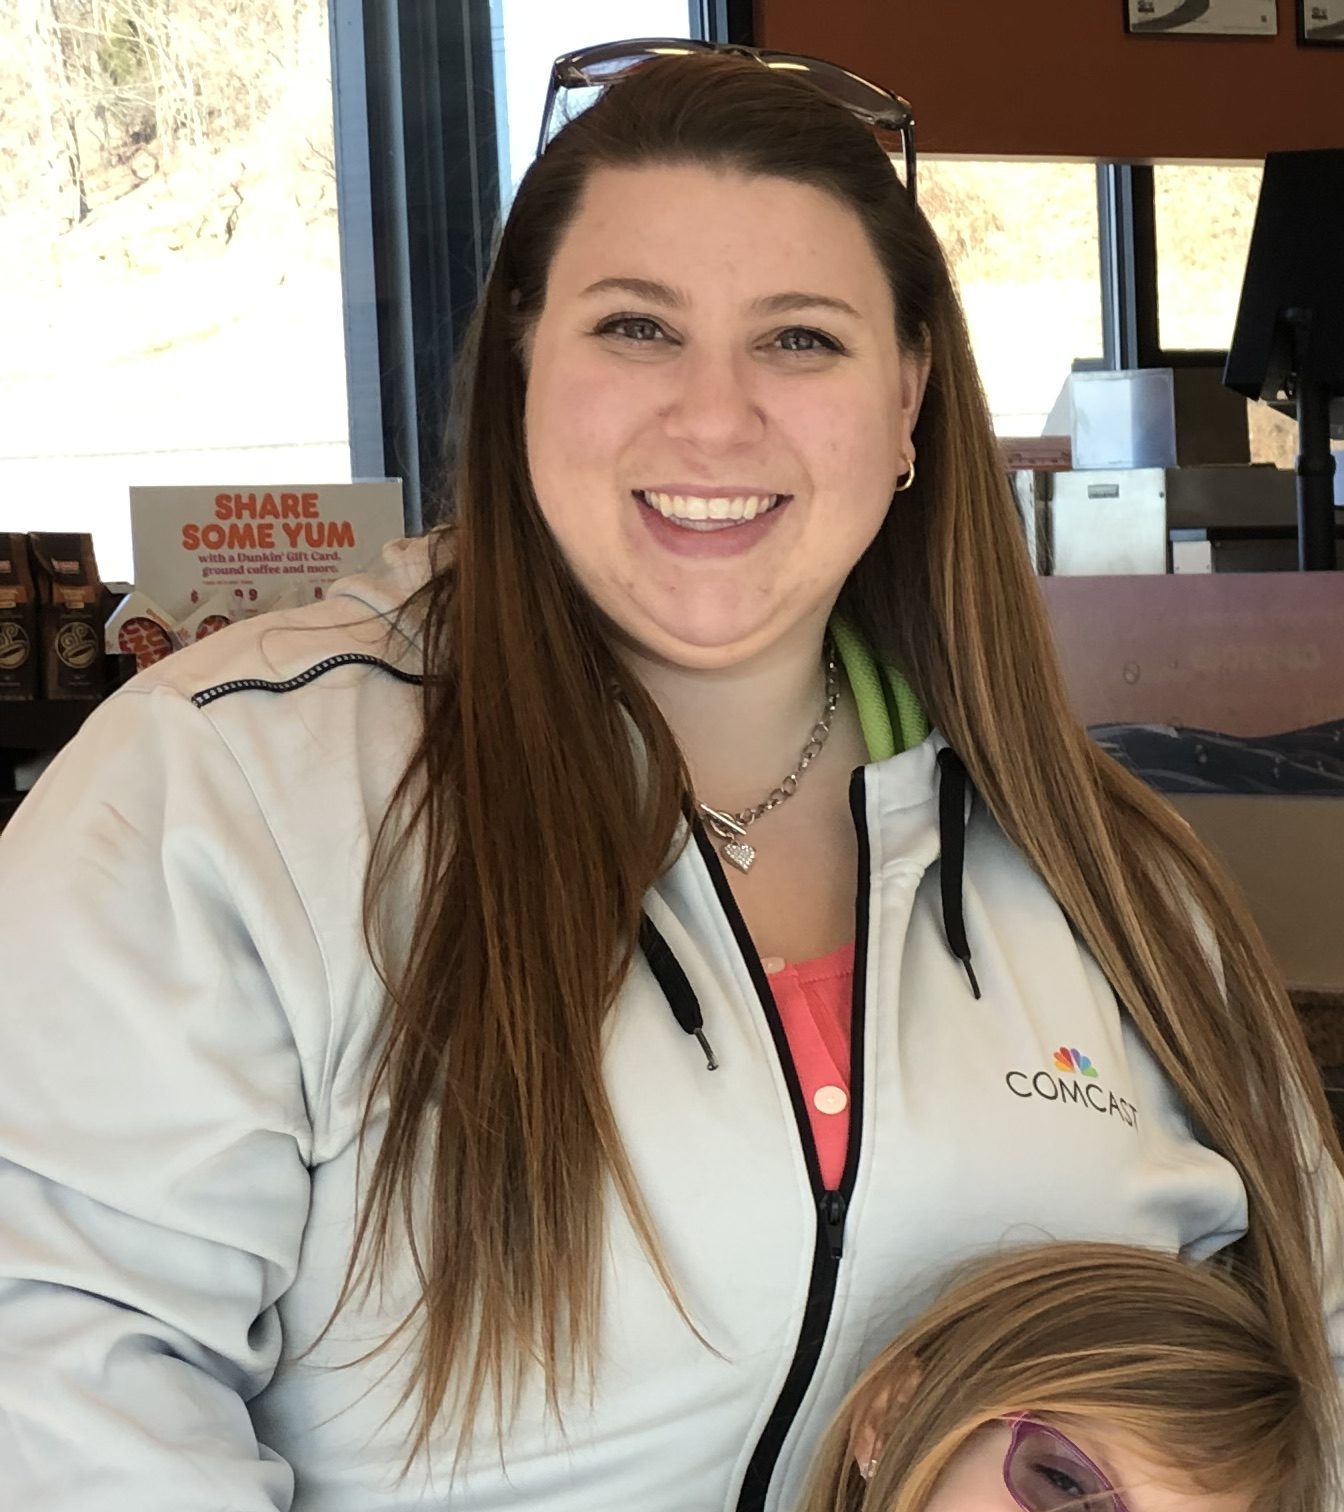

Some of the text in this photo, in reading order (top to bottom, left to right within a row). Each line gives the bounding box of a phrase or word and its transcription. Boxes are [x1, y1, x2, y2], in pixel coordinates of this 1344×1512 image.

[215, 493, 319, 519] SHARE
[182, 521, 355, 550] SOME YUM
[199, 552, 226, 563] with
[229, 555, 236, 563] a
[286, 551, 309, 563] Gift
[202, 566, 245, 577] ground
[248, 564, 280, 575] coffee
[282, 563, 304, 574] and
[1005, 1070, 1139, 1133] COMCAST
